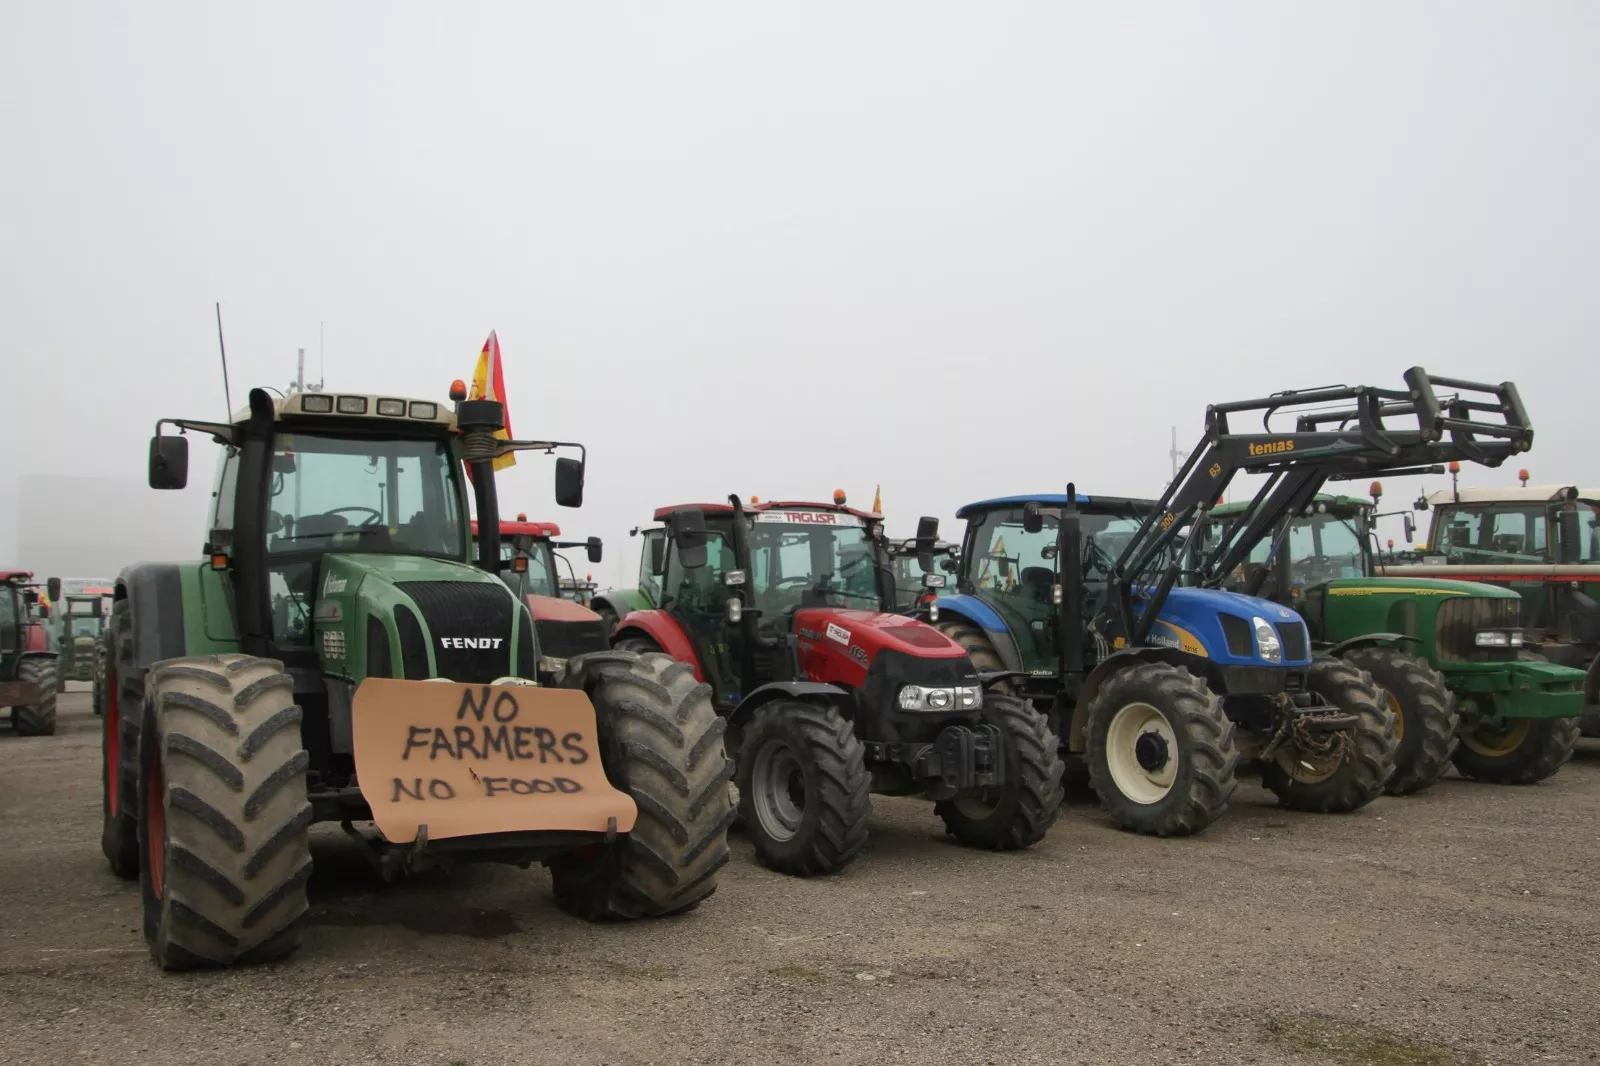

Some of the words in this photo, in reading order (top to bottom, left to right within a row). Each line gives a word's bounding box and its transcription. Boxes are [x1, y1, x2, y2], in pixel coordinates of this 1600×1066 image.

[1249, 440, 1295, 456] tenias
[1208, 462, 1222, 479] B3
[785, 512, 836, 524] TAGUSA
[440, 637, 503, 649] FENDT
[1151, 633, 1180, 649] Holland
[456, 686, 520, 723] NO
[402, 725, 589, 765] FARMERS
[391, 777, 456, 802] NO
[482, 777, 584, 797] FOOD
